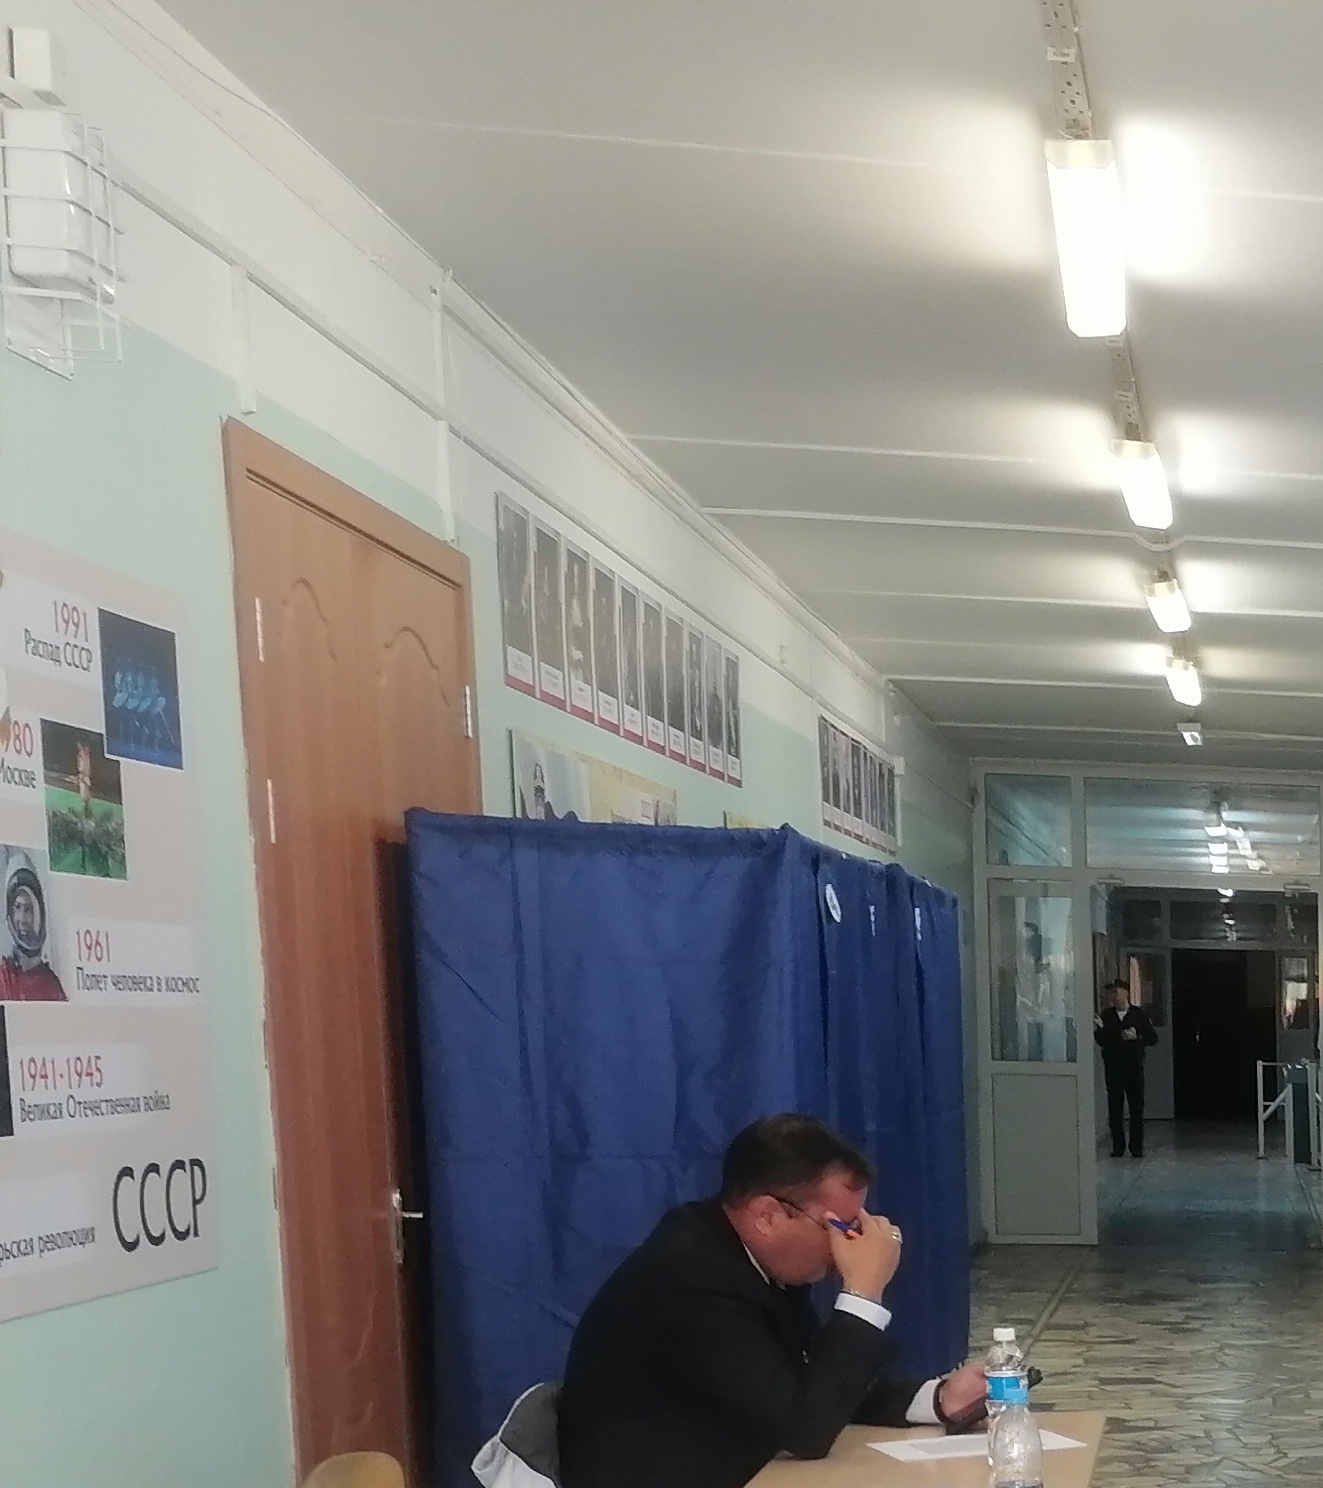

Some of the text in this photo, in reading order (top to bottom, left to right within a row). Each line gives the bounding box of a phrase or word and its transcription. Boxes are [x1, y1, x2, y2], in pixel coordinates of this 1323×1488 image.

[53, 600, 89, 643] 1991
[24, 628, 92, 672] Распад СССР
[4, 720, 34, 757] 80
[76, 929, 110, 962] 1961
[76, 966, 200, 993] Полет человека в космос
[20, 1055, 103, 1091] 1941-1945
[20, 1090, 170, 1123] Великая Отечественная война
[112, 1158, 207, 1253] СССР
[38, 1226, 95, 1258] революция
